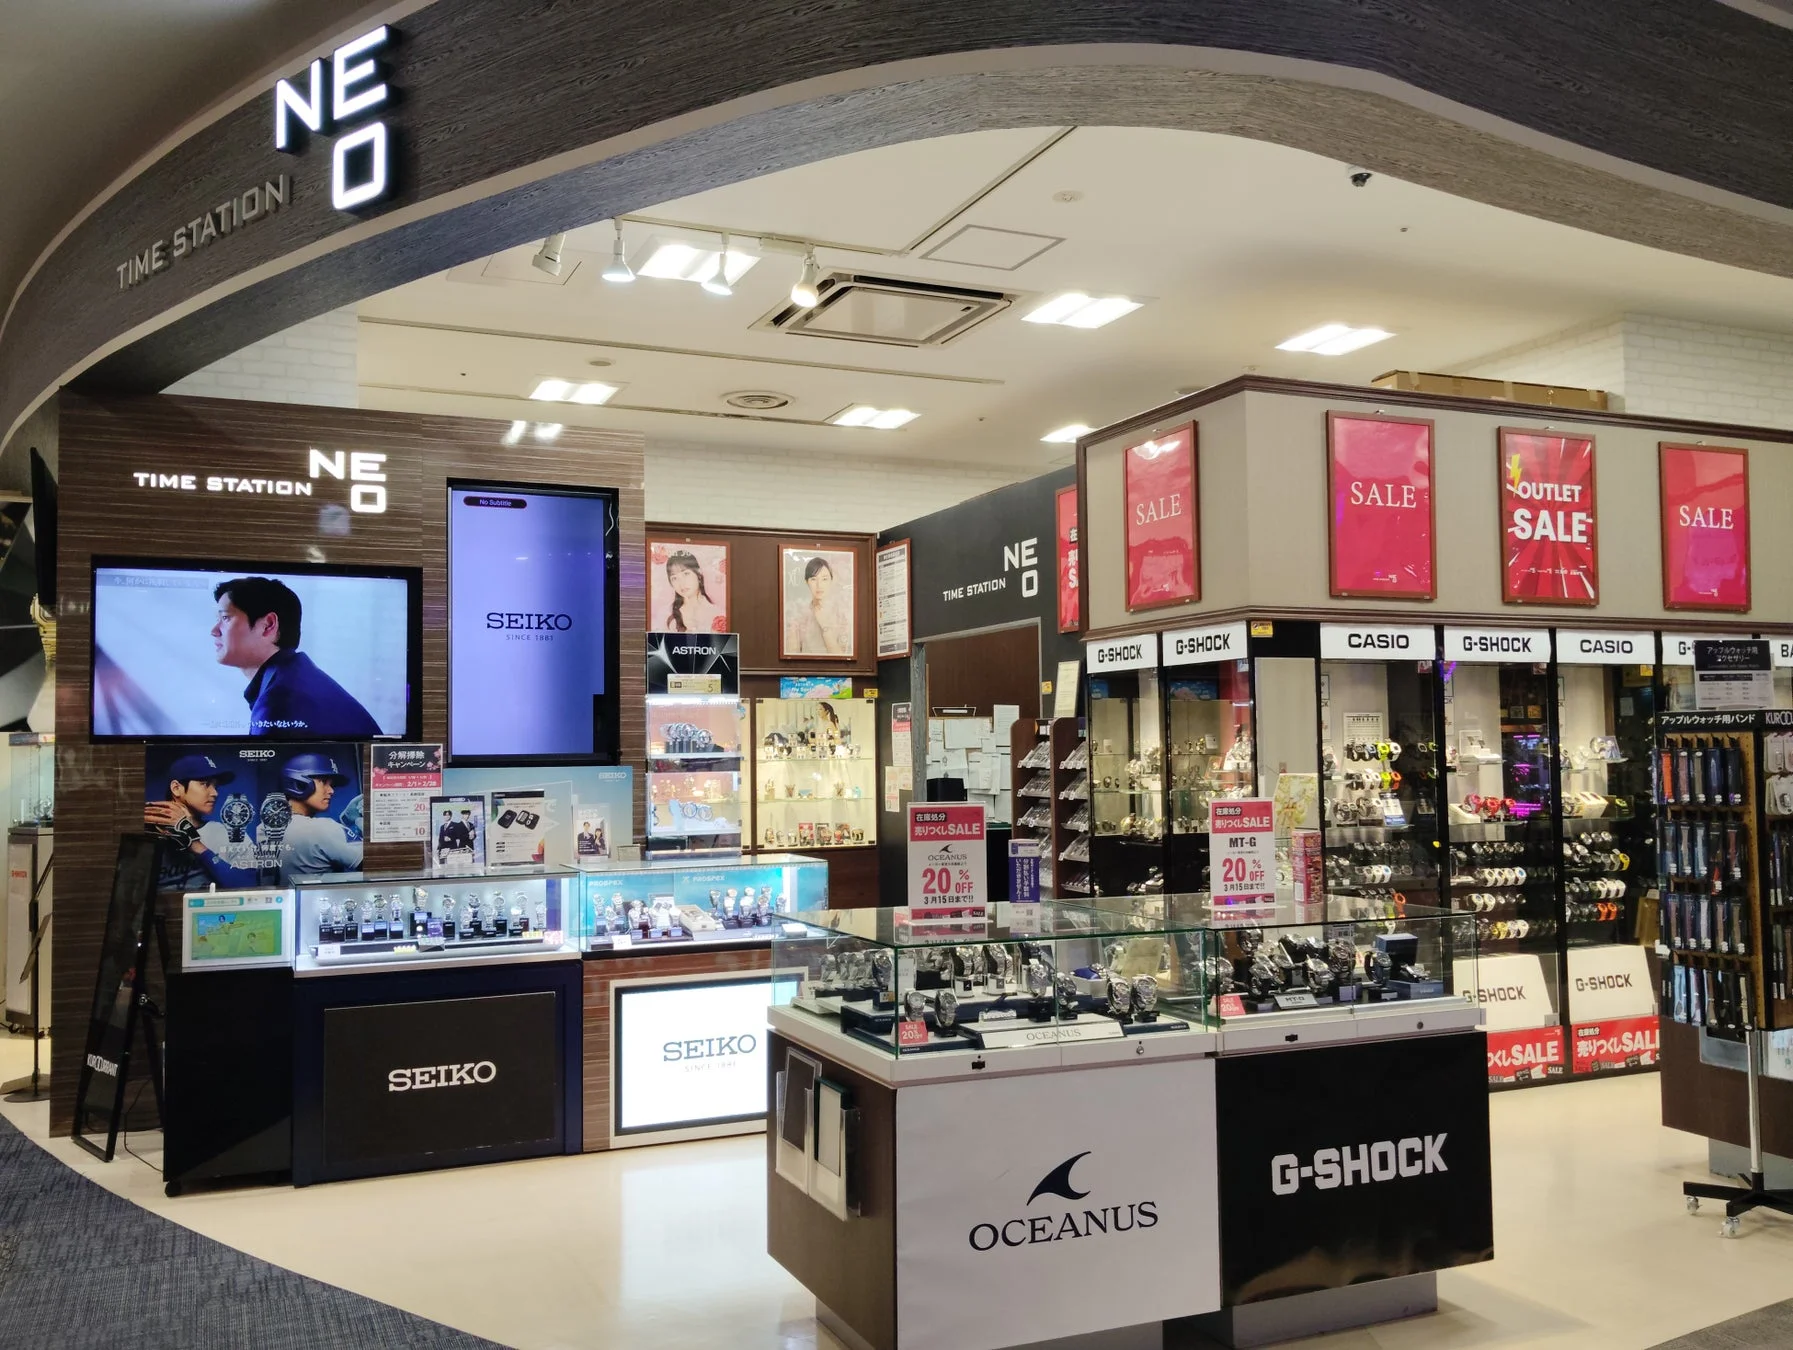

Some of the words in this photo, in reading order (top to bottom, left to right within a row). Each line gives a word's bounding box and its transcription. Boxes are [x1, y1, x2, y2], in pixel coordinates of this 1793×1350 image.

[116, 239, 164, 289] TIME
[173, 174, 289, 258] STATION
[133, 472, 197, 490] TIME
[206, 477, 312, 496] STATION
[1516, 481, 1581, 503] OUTLET
[1350, 481, 1417, 508] SALE
[1135, 494, 1182, 526] SALE
[1680, 505, 1734, 530] SALE
[1513, 509, 1588, 543] SALE
[943, 588, 964, 602] TIME
[966, 577, 1007, 598] STATION
[486, 612, 572, 631] SEIKO
[1176, 633, 1230, 655] G-SHOCK
[1348, 633, 1409, 649] CASIO
[1463, 636, 1532, 653] G-SHOCK
[1579, 640, 1634, 654] CASIO
[672, 646, 717, 656] ASTRON
[1098, 643, 1142, 663] G-SHOCK
[1661, 714, 1756, 725] アップルウォッチ用バンド
[239, 750, 276, 758] SEIKO
[388, 751, 425, 760] 分解掃除
[387, 761, 426, 769] キャンペーン
[414, 803, 426, 812] 20
[915, 813, 946, 822] 在庫処分
[915, 823, 981, 836] 売りつくしSALE
[1229, 837, 1256, 847] MT-G
[1222, 858, 1246, 882] 20
[1250, 872, 1264, 881] OFF
[922, 868, 951, 894] 20
[955, 882, 973, 893] OFF
[1576, 974, 1632, 991] G-SHOCK
[1463, 987, 1526, 1003] G-SHOCK
[902, 1030, 913, 1039] 20
[1026, 1030, 1081, 1041] OCEANUS
[663, 1034, 757, 1062] SEIKO
[388, 1061, 497, 1092] SEIKO
[1271, 1133, 1448, 1196] G-SHOCK
[969, 1201, 1159, 1251] OCEANUS
